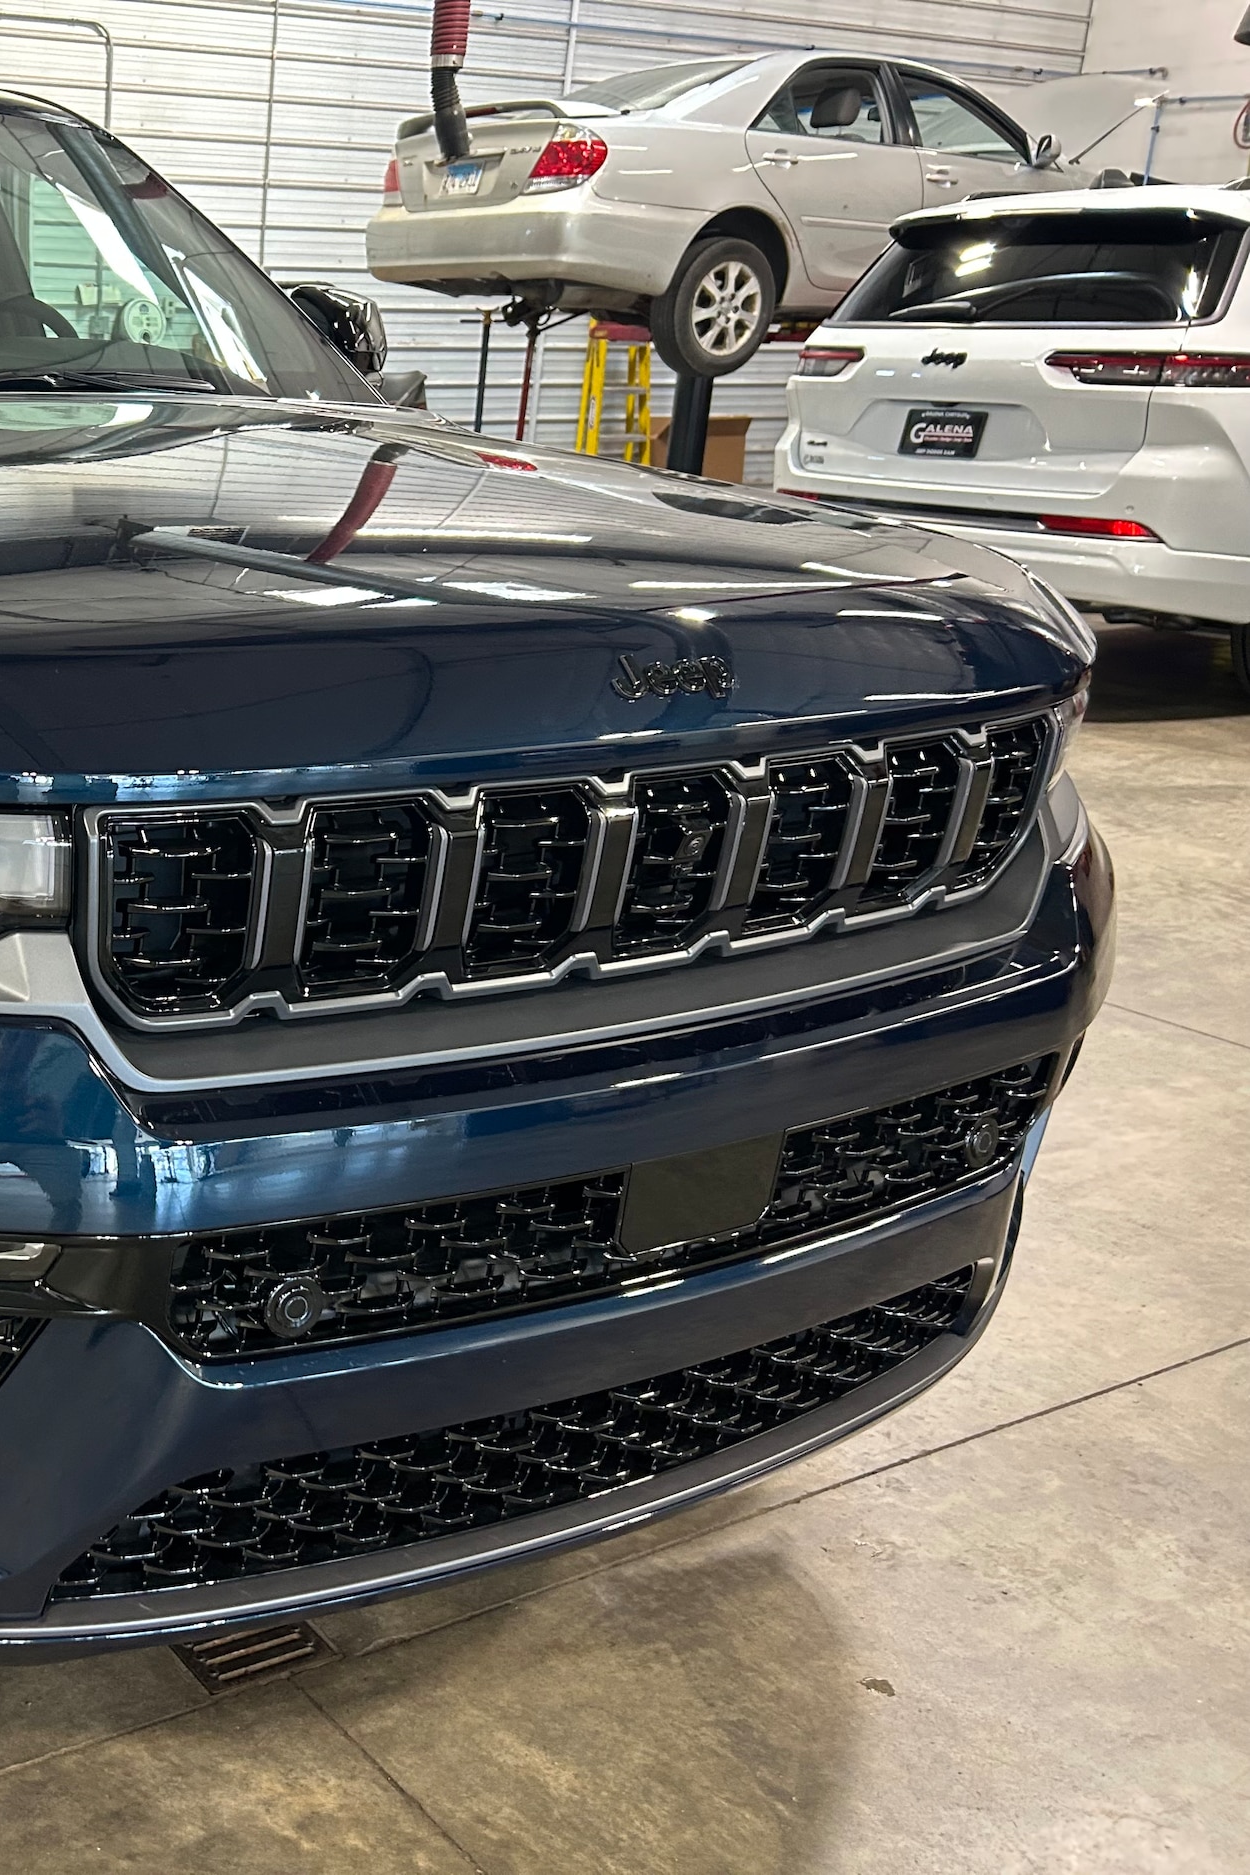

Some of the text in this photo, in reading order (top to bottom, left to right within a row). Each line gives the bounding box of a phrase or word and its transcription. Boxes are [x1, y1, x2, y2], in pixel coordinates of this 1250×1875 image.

[921, 347, 968, 370] Jeep
[910, 422, 974, 443] GALENA
[611, 654, 735, 700] Jeep
